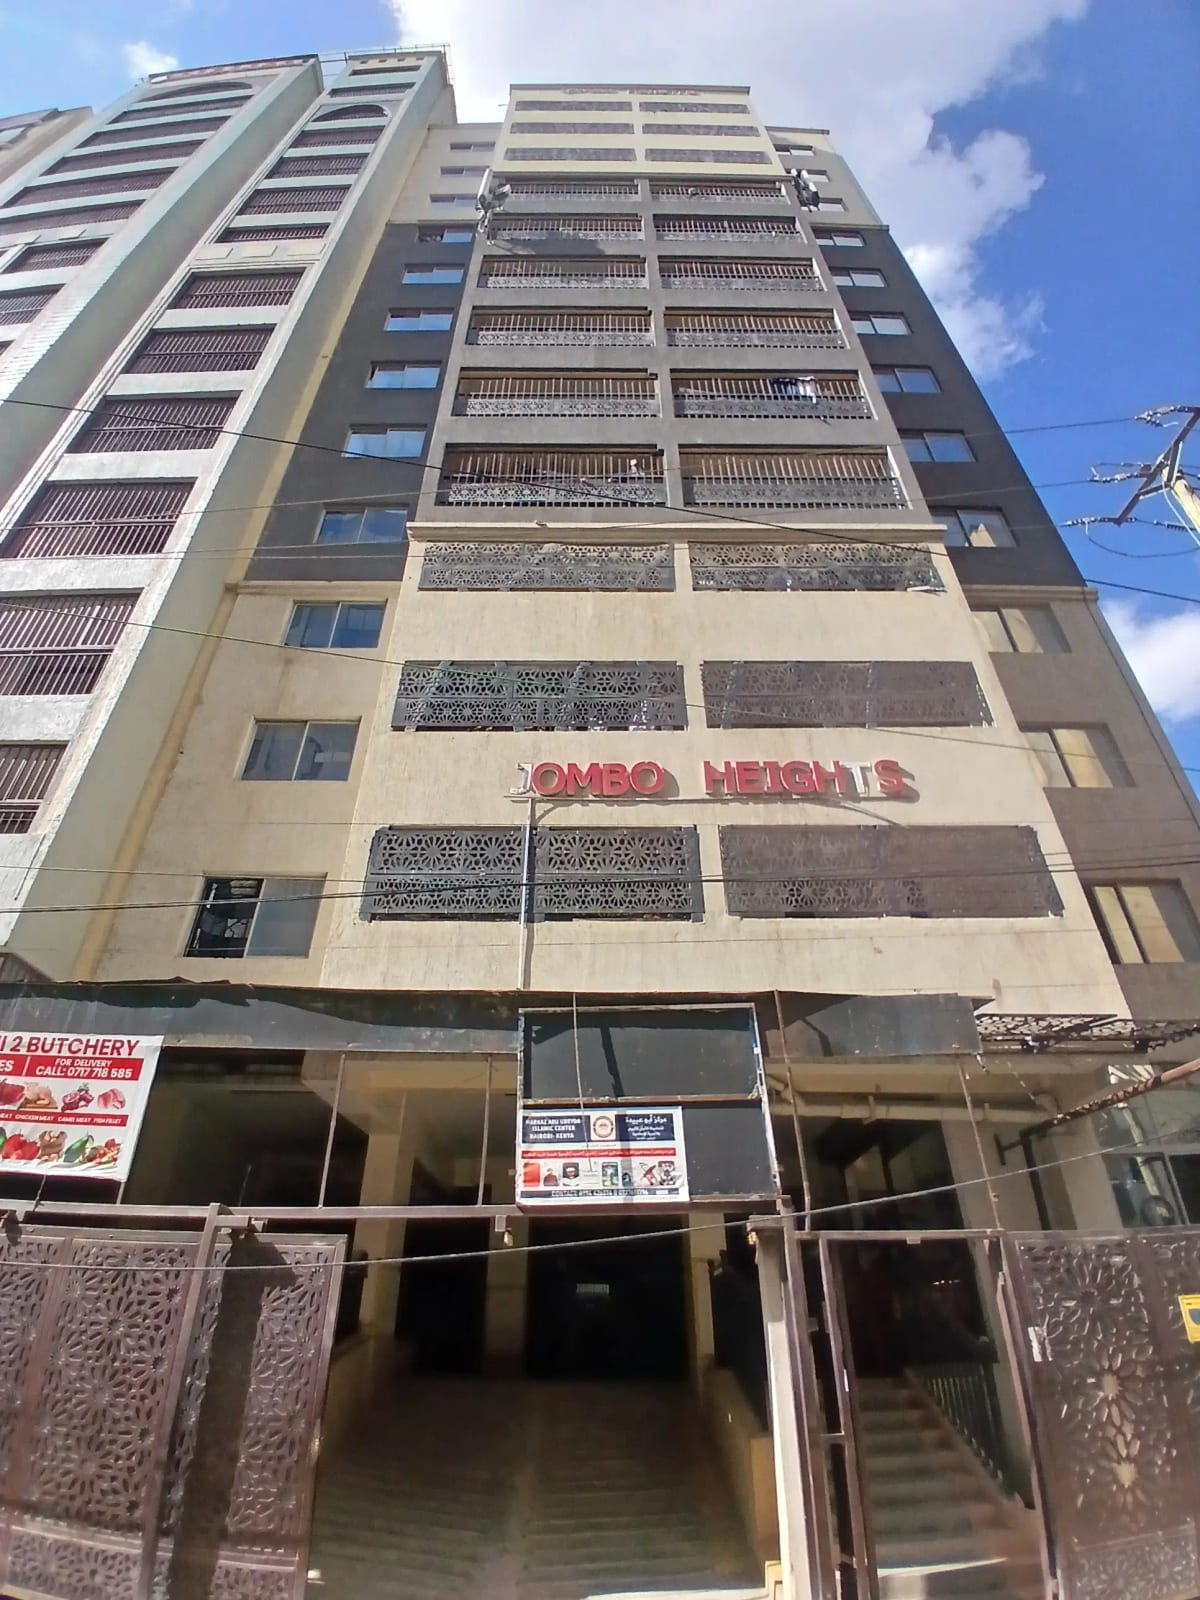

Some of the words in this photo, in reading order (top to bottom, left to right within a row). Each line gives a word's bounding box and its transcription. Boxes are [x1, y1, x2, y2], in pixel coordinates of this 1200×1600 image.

[510, 761, 666, 796] JOMBO
[703, 760, 906, 794] HEIGHTS
[10, 1036, 23, 1053] 2
[26, 1037, 140, 1057] BUTCHERY
[35, 1066, 66, 1077] CALL:
[110, 1068, 133, 1079] 585
[74, 1060, 112, 1068] DELIVERY
